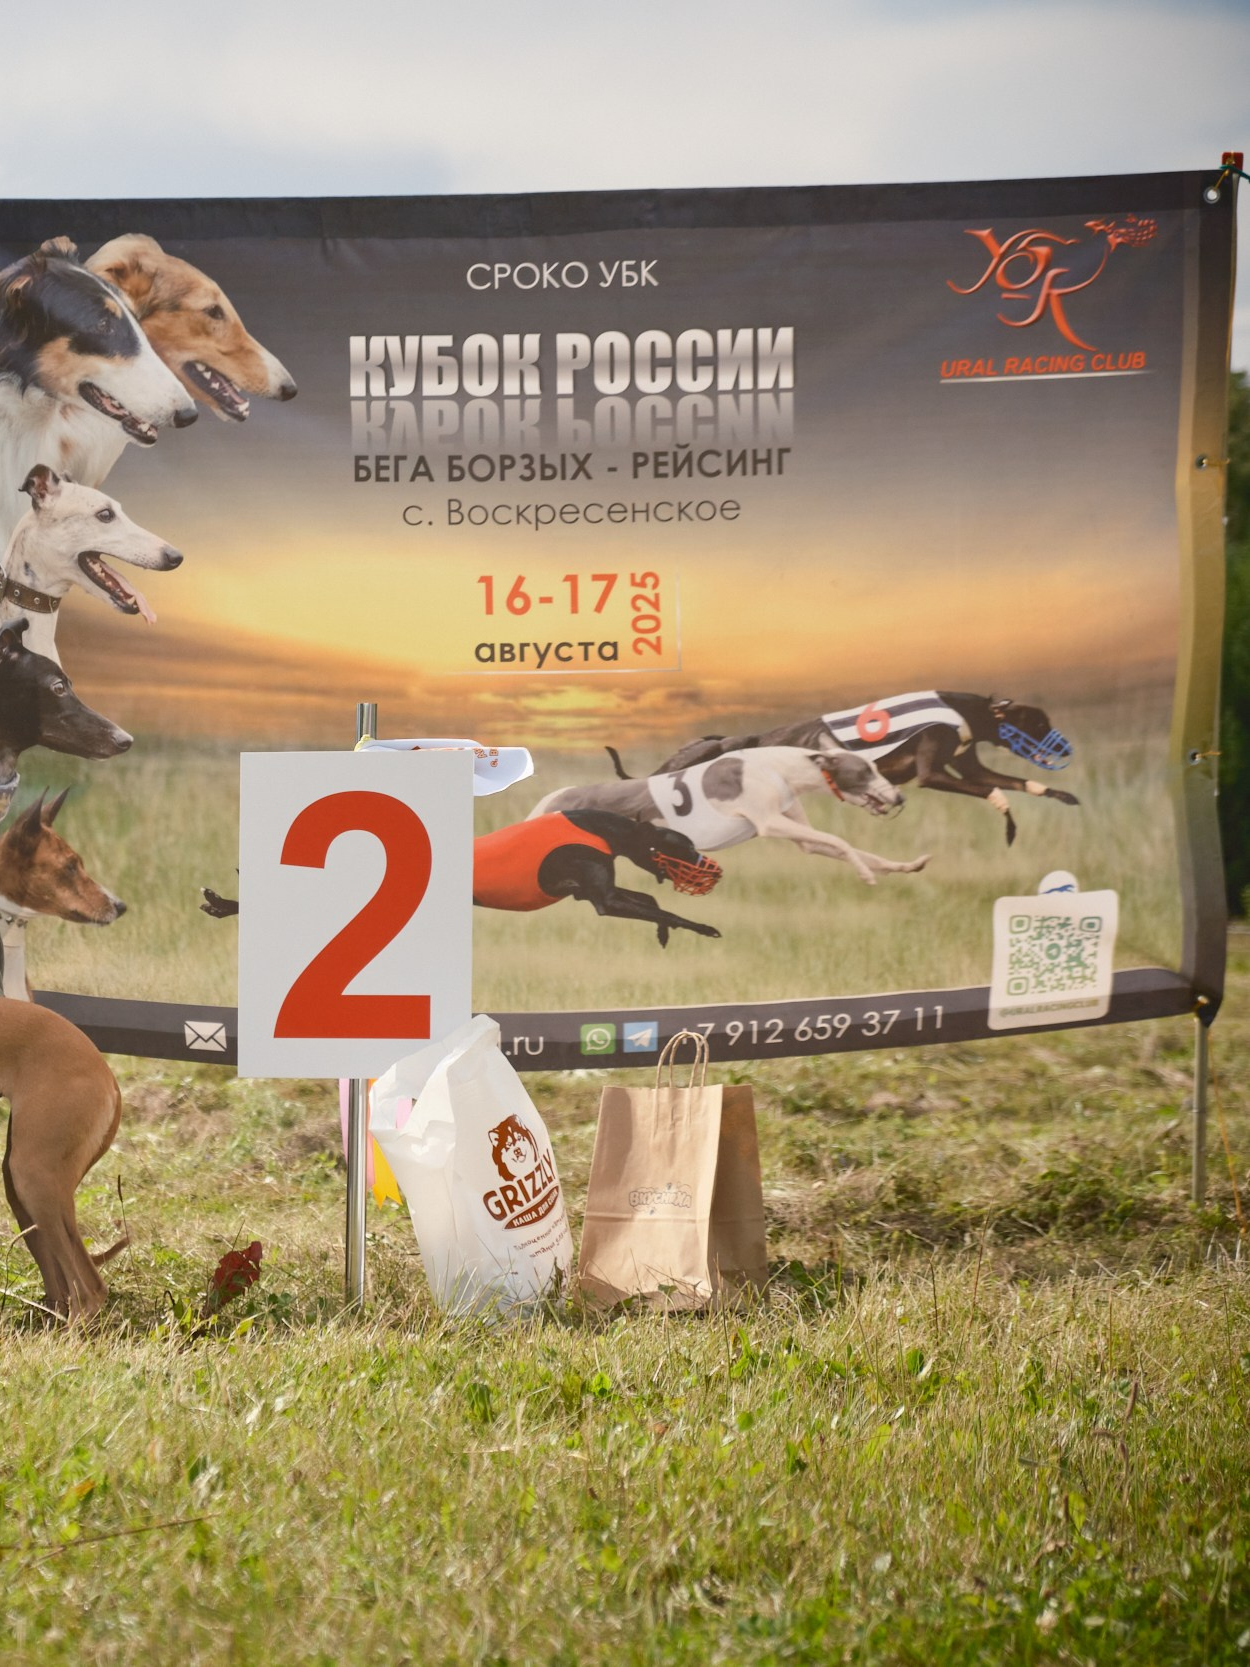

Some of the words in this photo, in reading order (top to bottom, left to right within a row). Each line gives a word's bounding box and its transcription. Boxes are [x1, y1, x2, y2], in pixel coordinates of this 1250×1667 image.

[466, 260, 589, 291] СРОКО
[599, 258, 660, 288] УБК
[349, 332, 542, 398] КУБОК
[555, 326, 795, 396] РОССИИ
[939, 358, 998, 378] URAL
[1003, 354, 1086, 375] RACING
[1090, 351, 1146, 371] CLUB
[353, 455, 435, 483] БЕГА
[448, 453, 594, 482] БОРЗЫХ
[631, 444, 793, 480] РЕЙСИНГ
[403, 504, 434, 526] с.
[446, 498, 741, 531] Воскресенское
[477, 573, 618, 616] 16-17
[630, 571, 662, 656] 2025
[474, 640, 619, 669] августа
[855, 701, 890, 743] 6
[667, 770, 694, 817] 3
[273, 790, 432, 1040] 2
[725, 1018, 784, 1046] 912
[794, 1013, 852, 1042] 659
[861, 1009, 902, 1037] 37
[914, 1005, 944, 1032] 11
[482, 1148, 557, 1222] GRIZZLY
